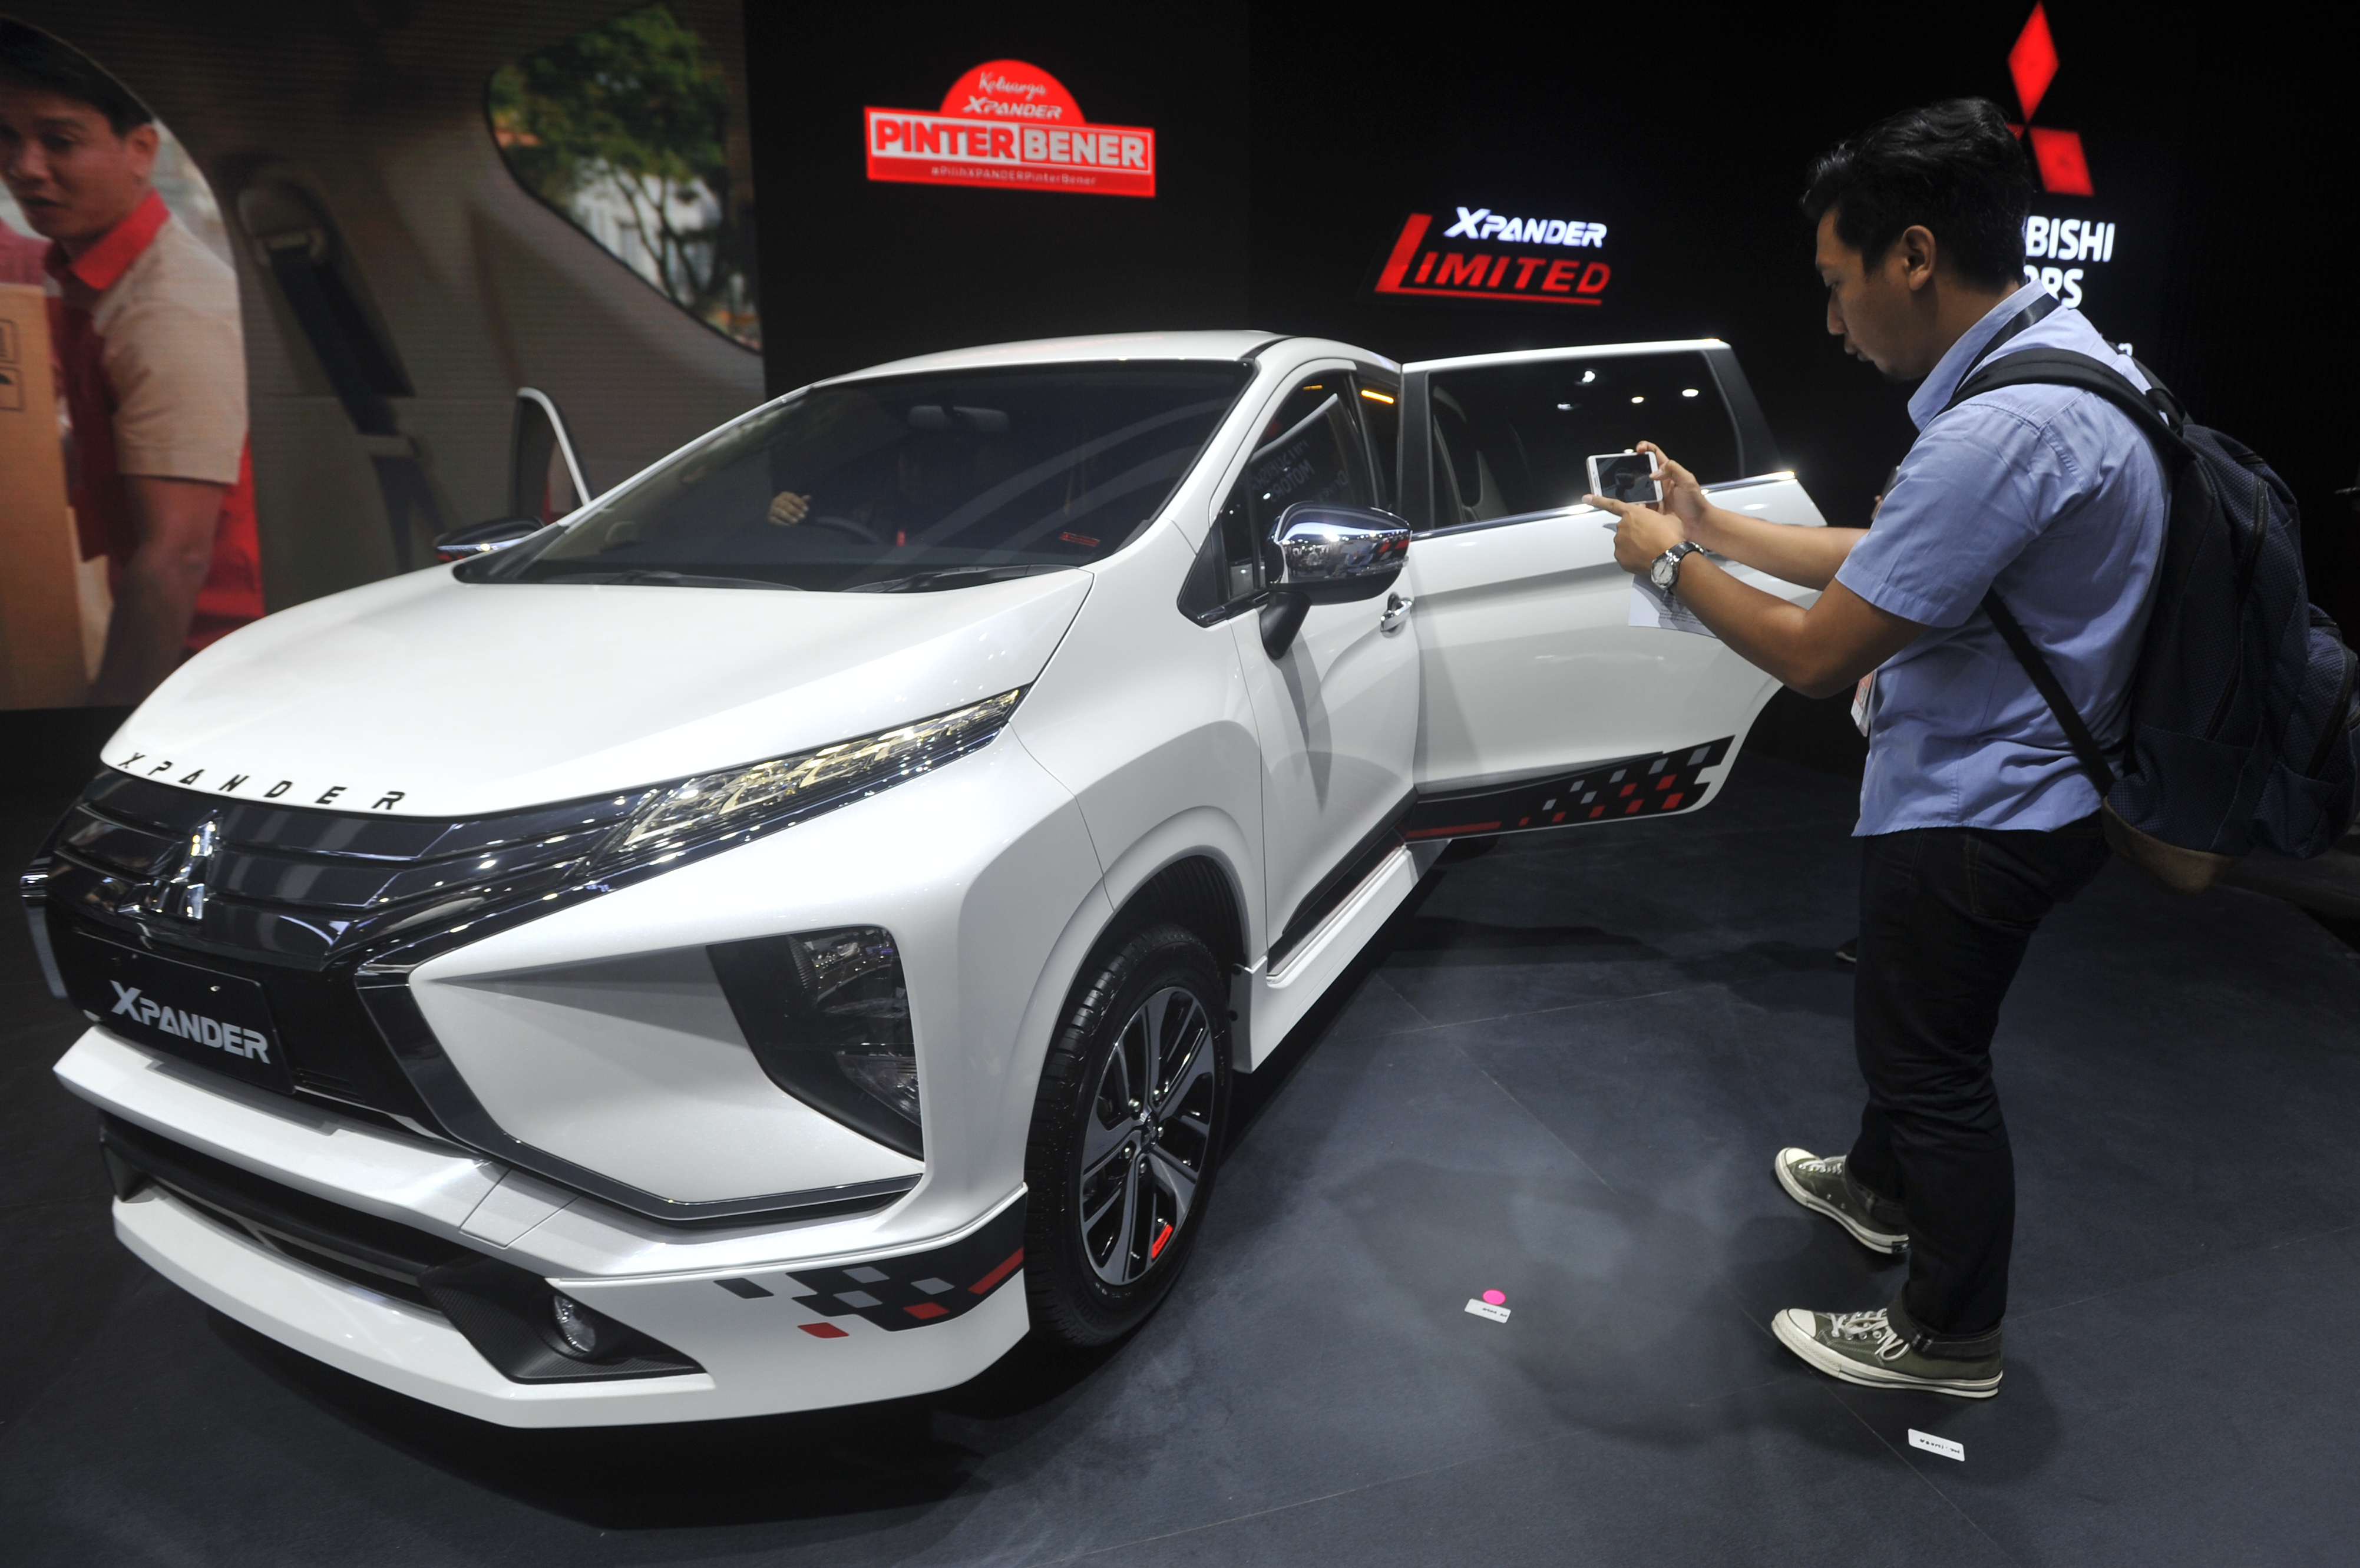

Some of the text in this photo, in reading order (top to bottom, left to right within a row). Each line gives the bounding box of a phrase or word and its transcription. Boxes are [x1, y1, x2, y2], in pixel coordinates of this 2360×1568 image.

[963, 95, 1062, 120] XPANDER
[979, 71, 1046, 100] Keluarga
[875, 119, 1146, 168] PINTER BENER
[1444, 207, 1607, 248] XPANDER
[2025, 216, 2116, 263] BISHI
[1374, 213, 1612, 305] LIMITED
[118, 752, 406, 810] XPANDER
[110, 980, 270, 1064] XPANDER
